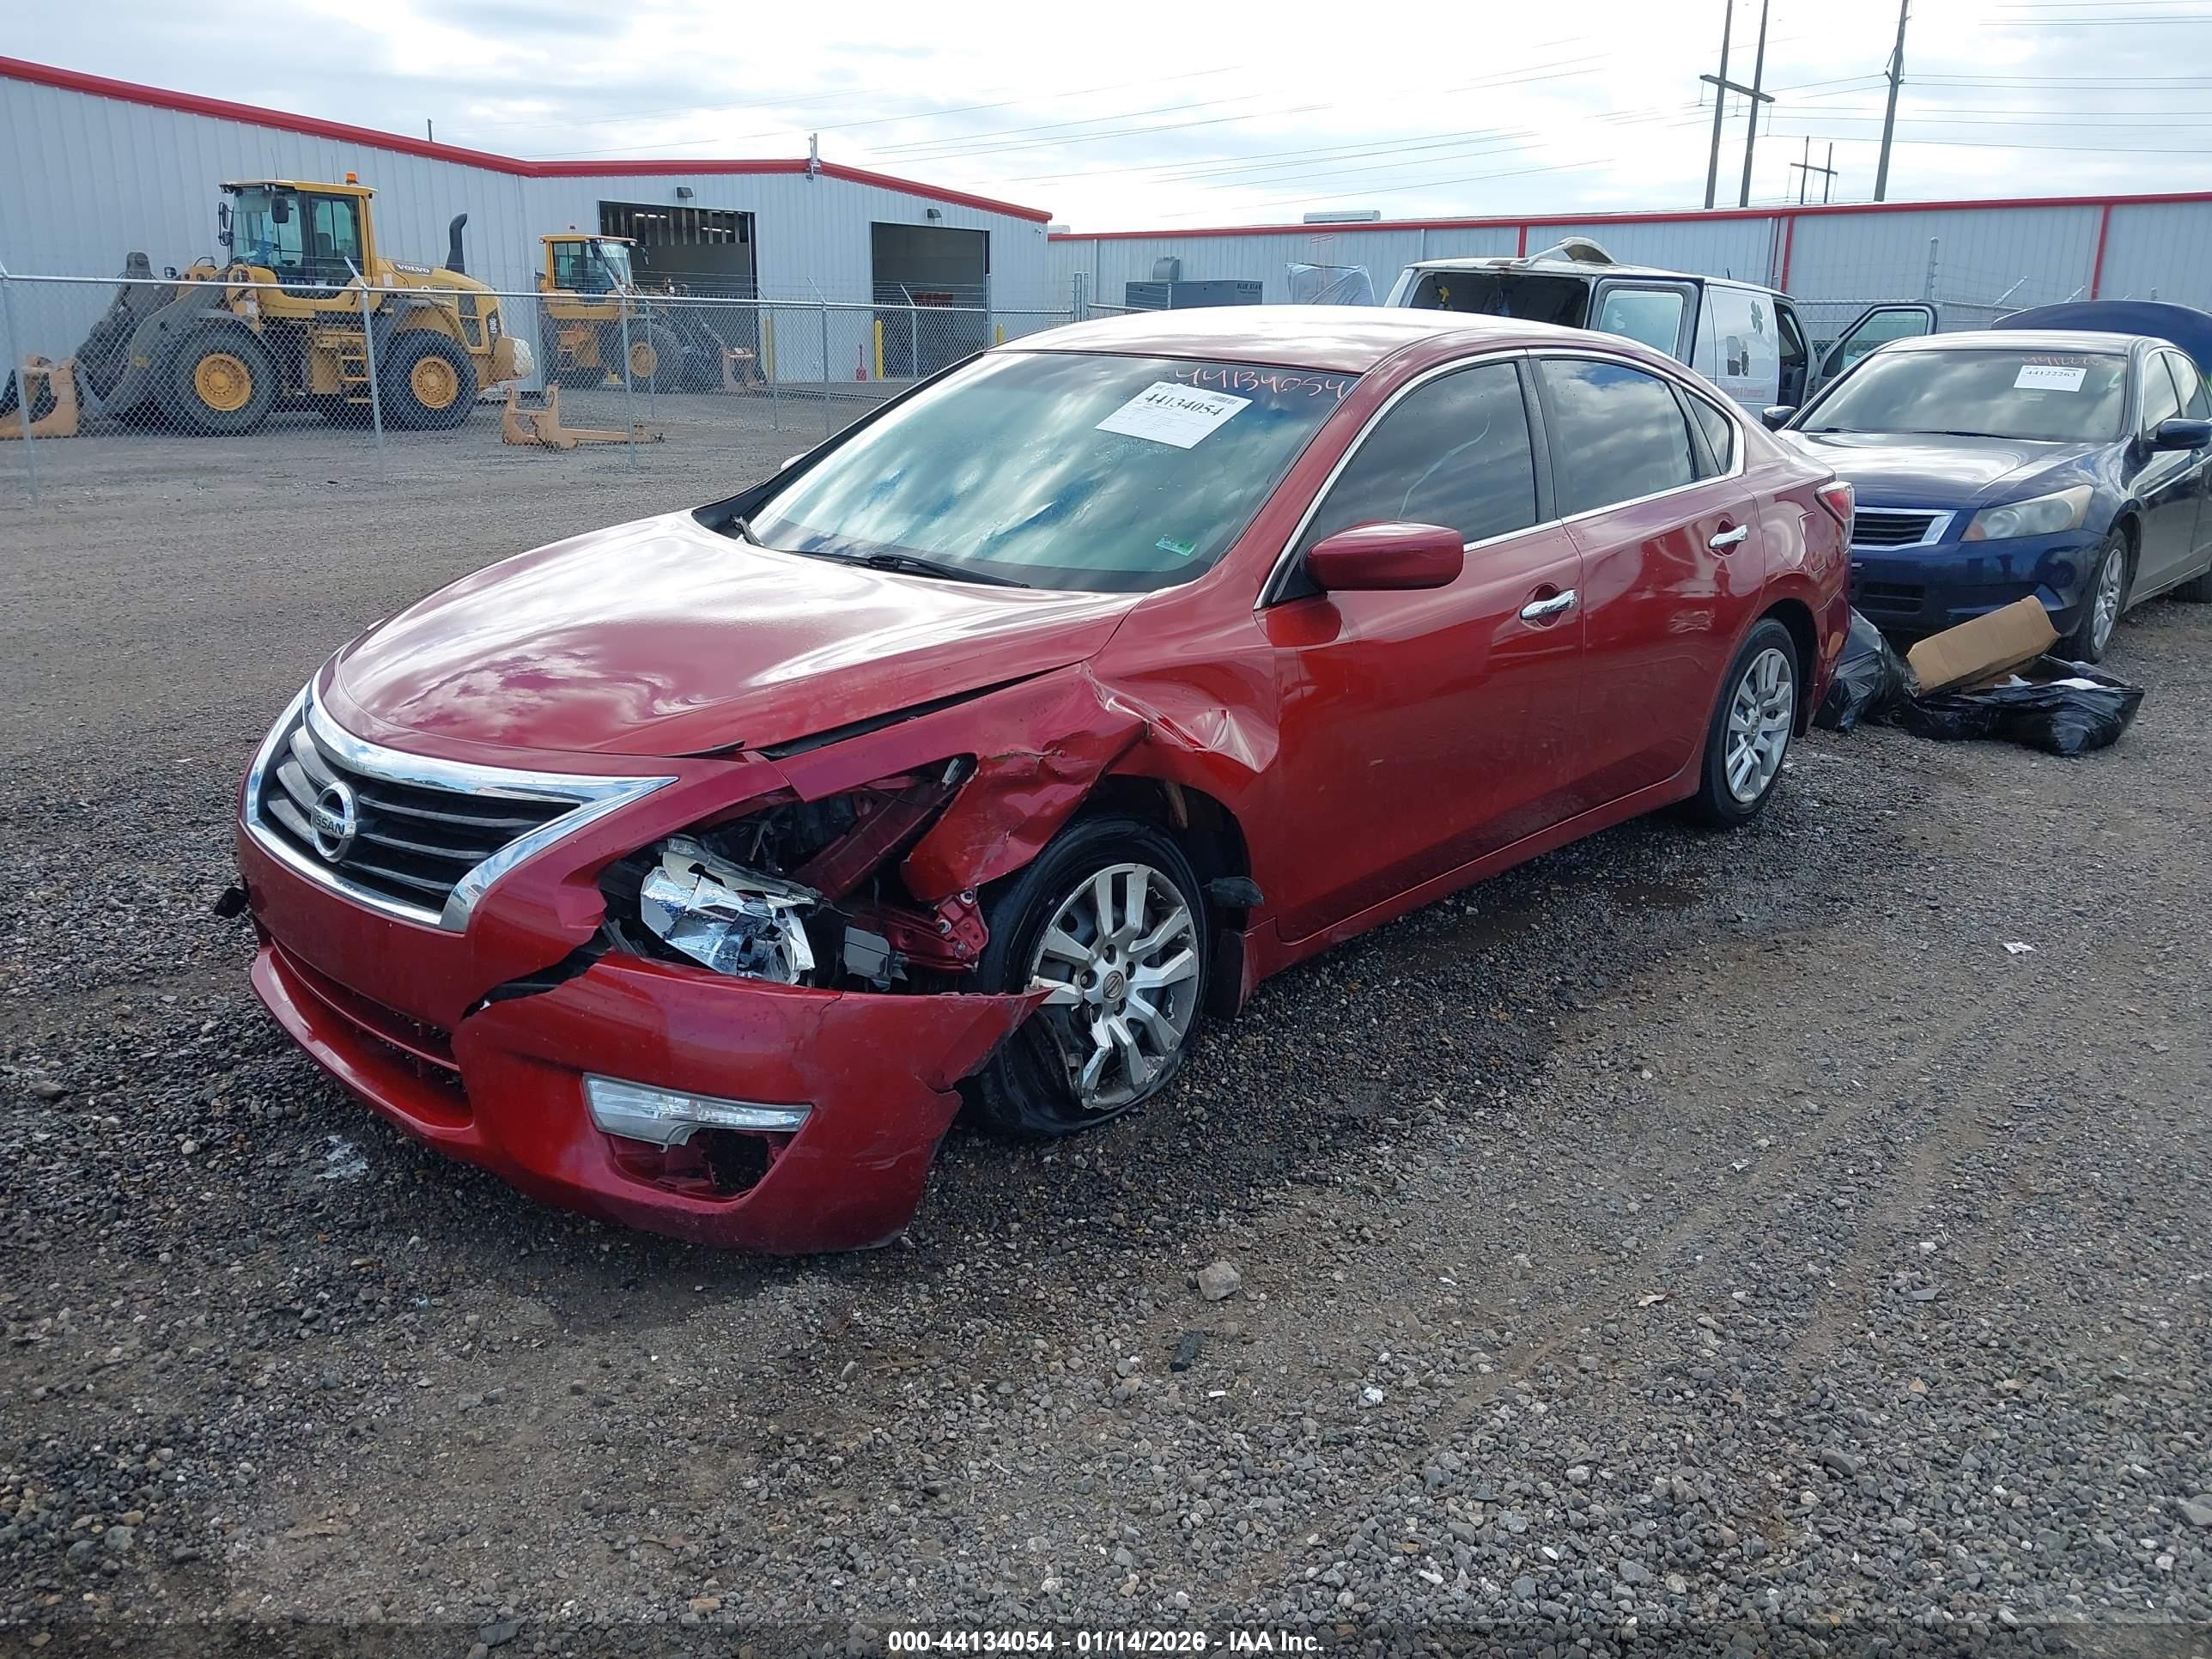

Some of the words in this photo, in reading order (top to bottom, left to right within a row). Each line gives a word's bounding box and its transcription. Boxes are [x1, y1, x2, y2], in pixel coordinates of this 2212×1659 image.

[396, 264, 430, 273] VOLVO
[1176, 368, 1346, 399] 44134054
[1145, 392, 1225, 416] 44134054
[315, 814, 345, 836] SSAN
